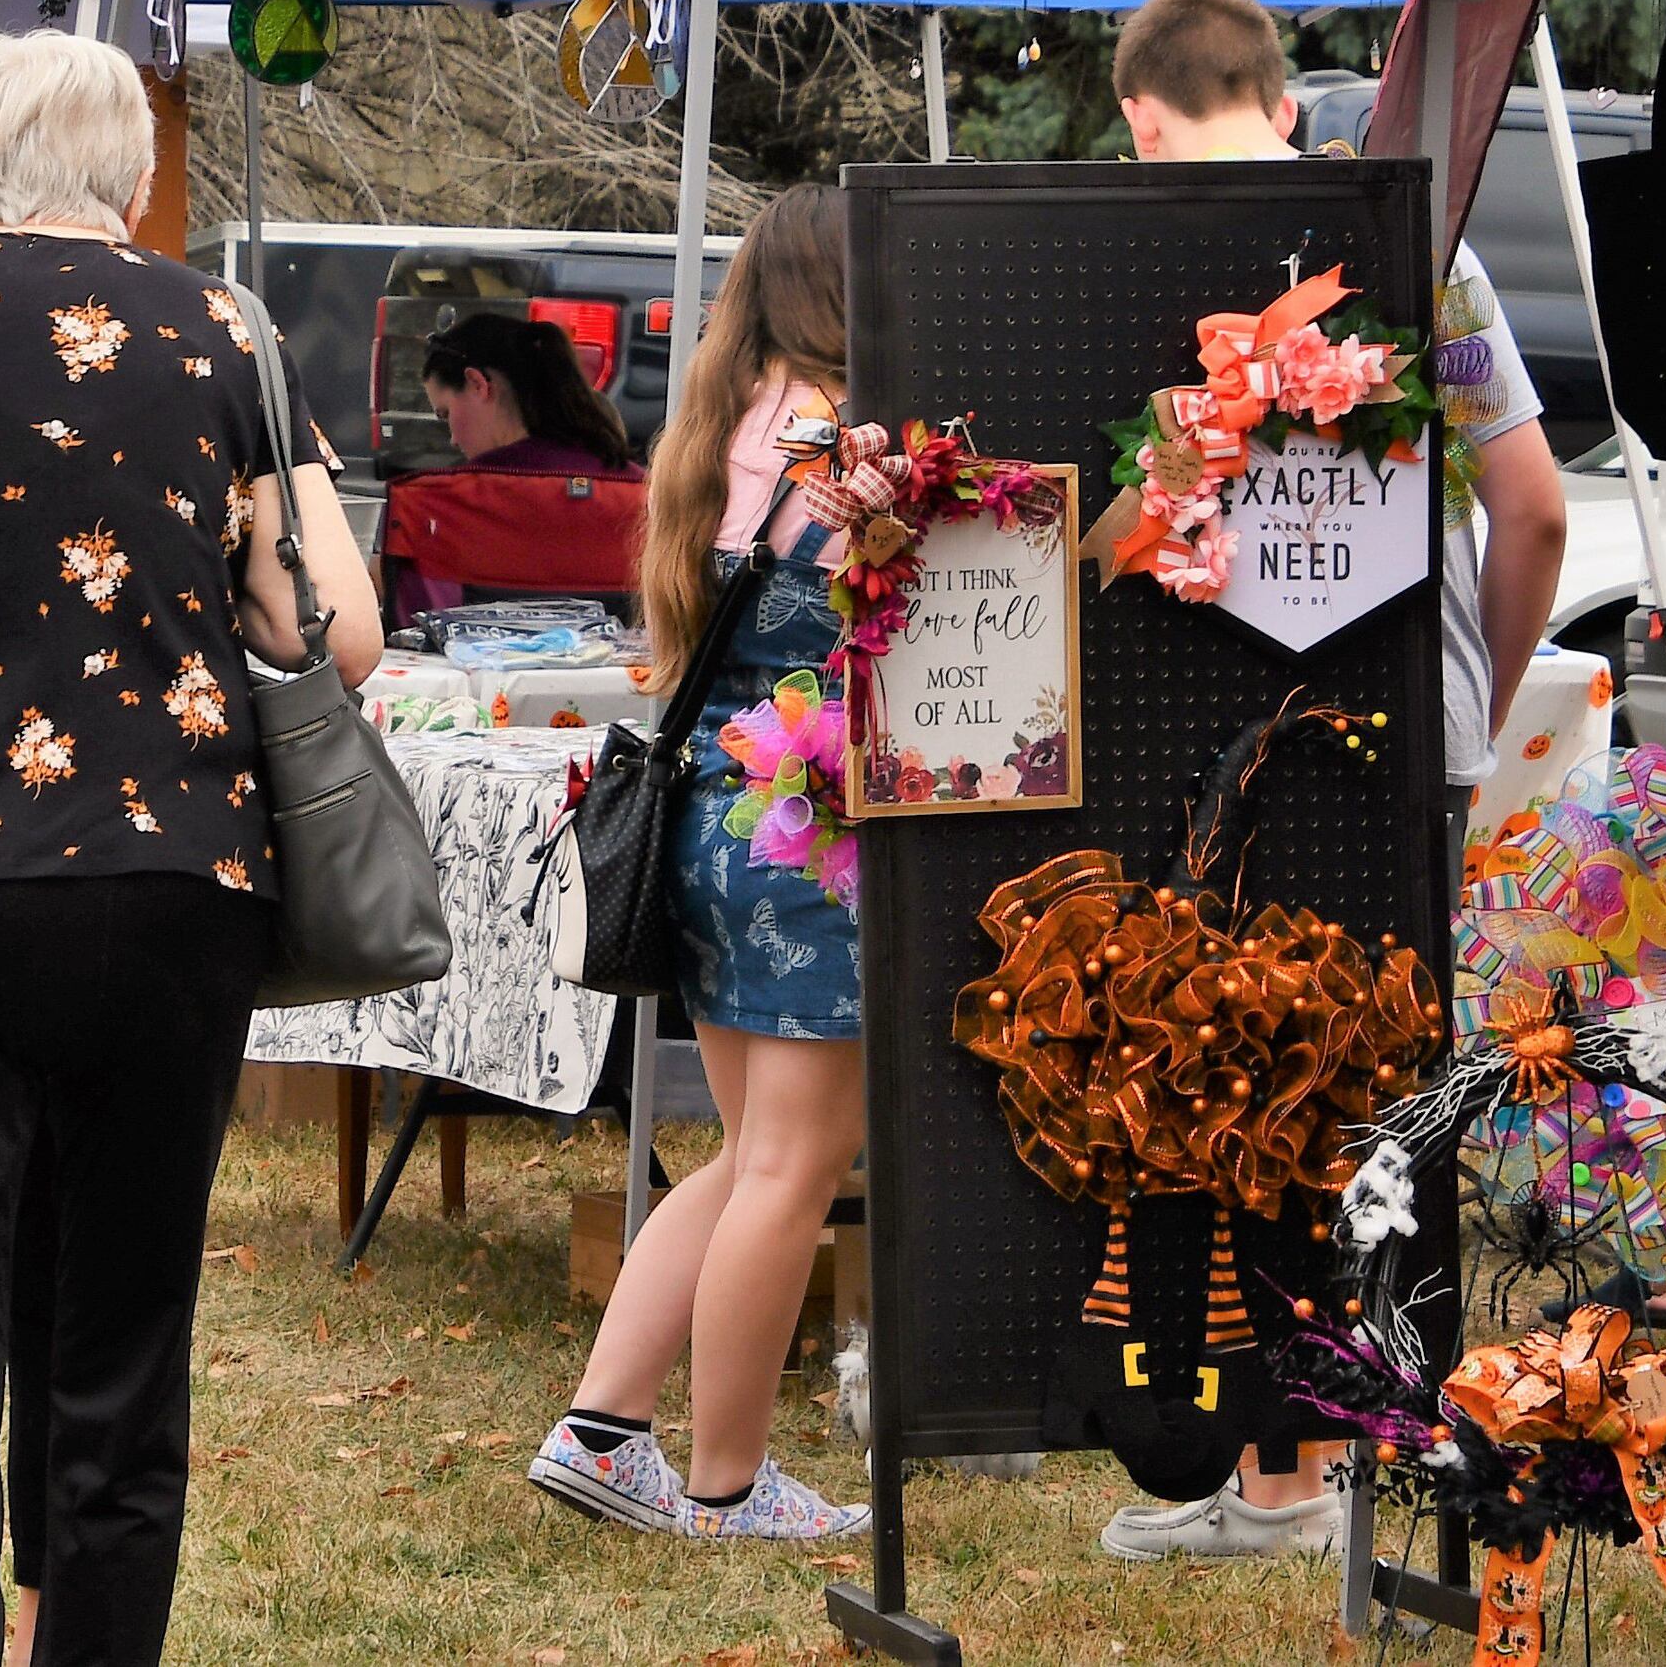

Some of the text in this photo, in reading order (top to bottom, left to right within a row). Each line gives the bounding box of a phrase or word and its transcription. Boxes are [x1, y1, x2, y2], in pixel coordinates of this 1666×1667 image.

[1221, 467, 1396, 506] XACTLY
[1260, 522, 1353, 532] WHERE YOU
[1259, 542, 1351, 581] NEED
[947, 570, 952, 591] I
[959, 568, 1018, 591] THINK
[1283, 596, 1328, 606] TO BE
[904, 594, 1047, 655] love fall
[926, 665, 989, 690] MOST
[914, 699, 1003, 727] OF ALL
